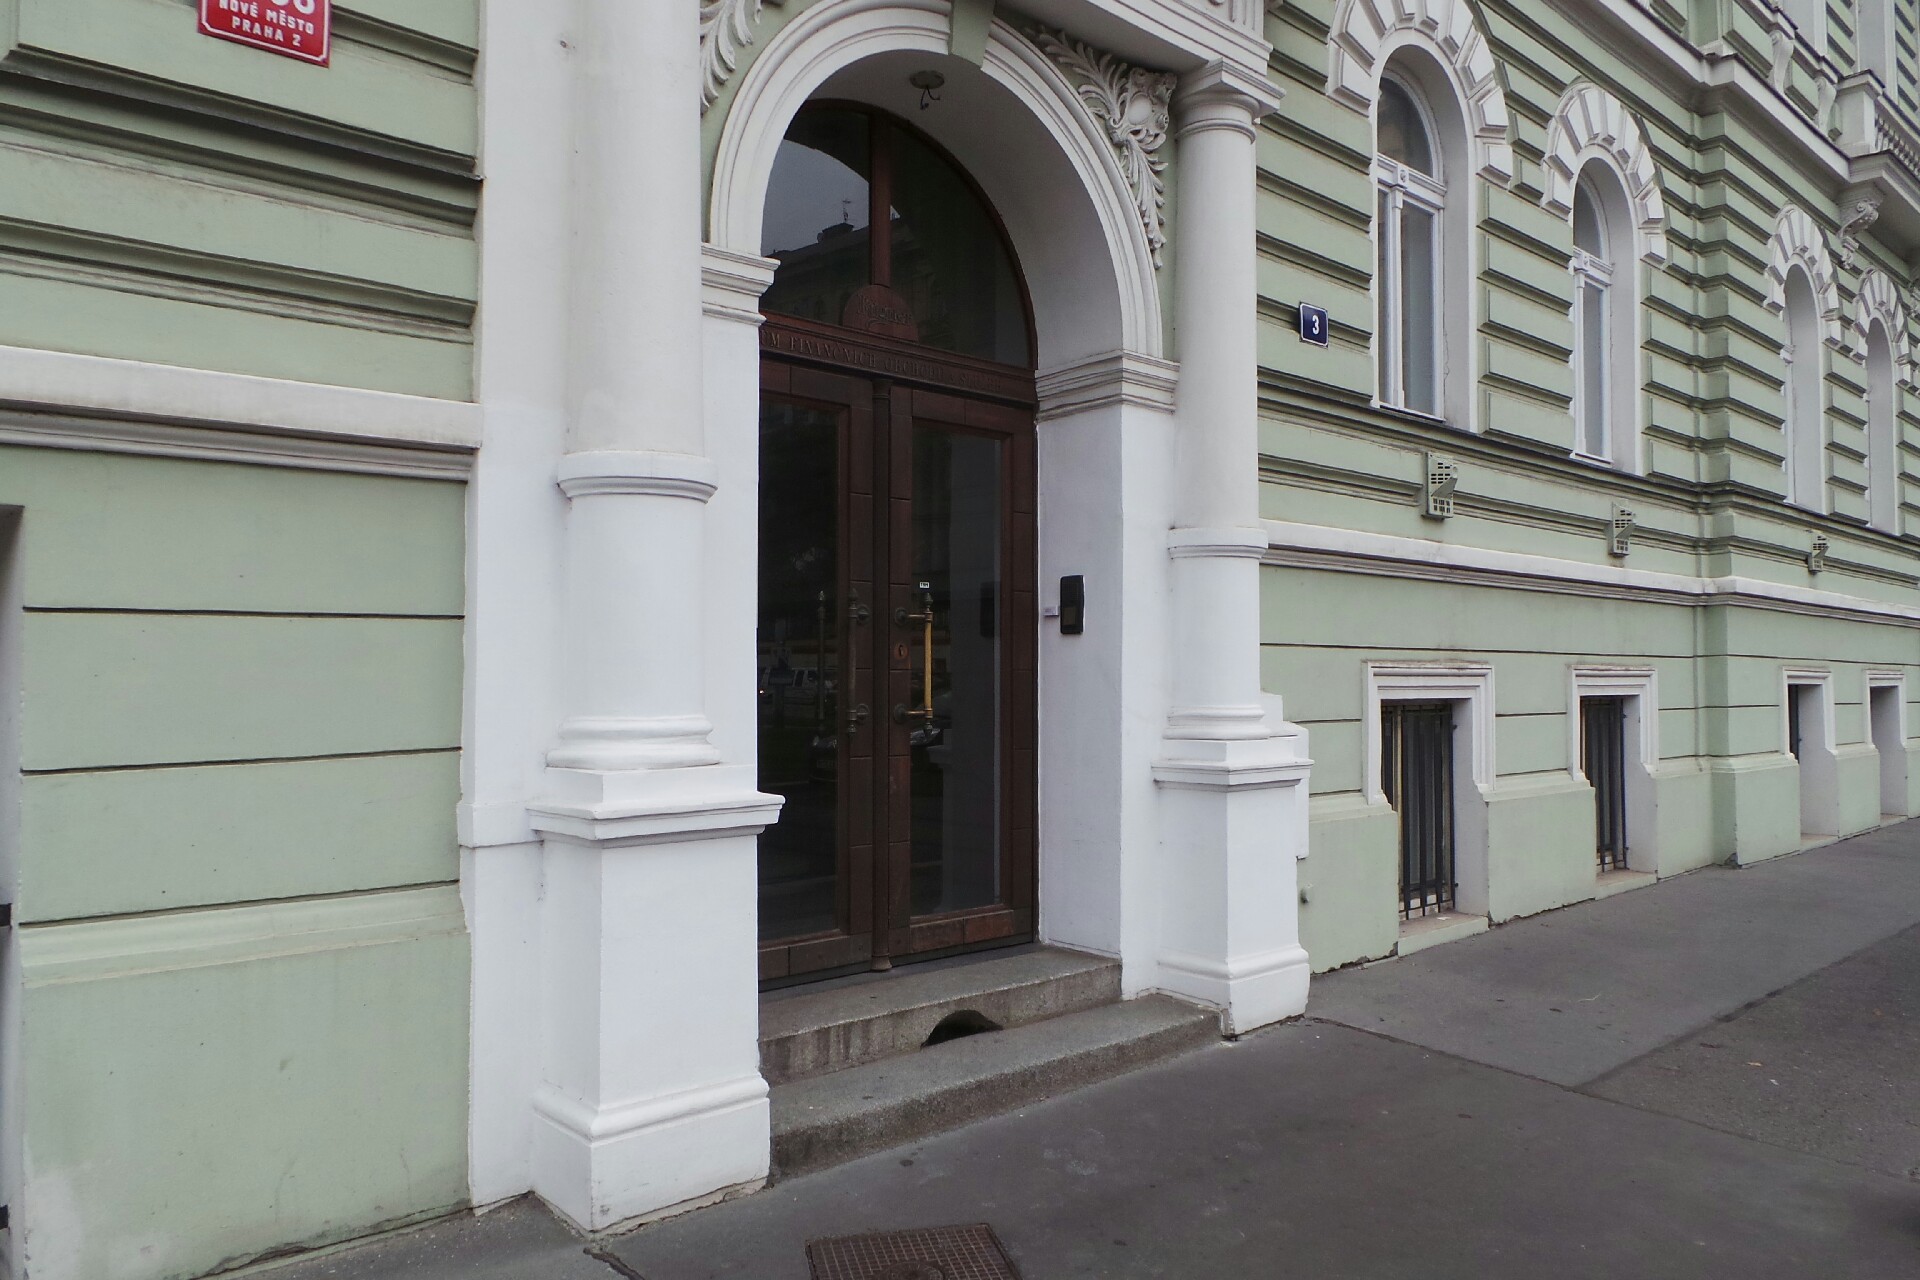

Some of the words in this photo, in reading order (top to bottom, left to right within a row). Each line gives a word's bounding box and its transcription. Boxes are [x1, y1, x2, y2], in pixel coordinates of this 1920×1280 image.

[219, 0, 259, 18] NOVÉ
[265, 8, 314, 35] MĚSTO
[231, 15, 284, 42] PRAHA
[292, 34, 302, 47] 2
[1312, 314, 1320, 335] 3
